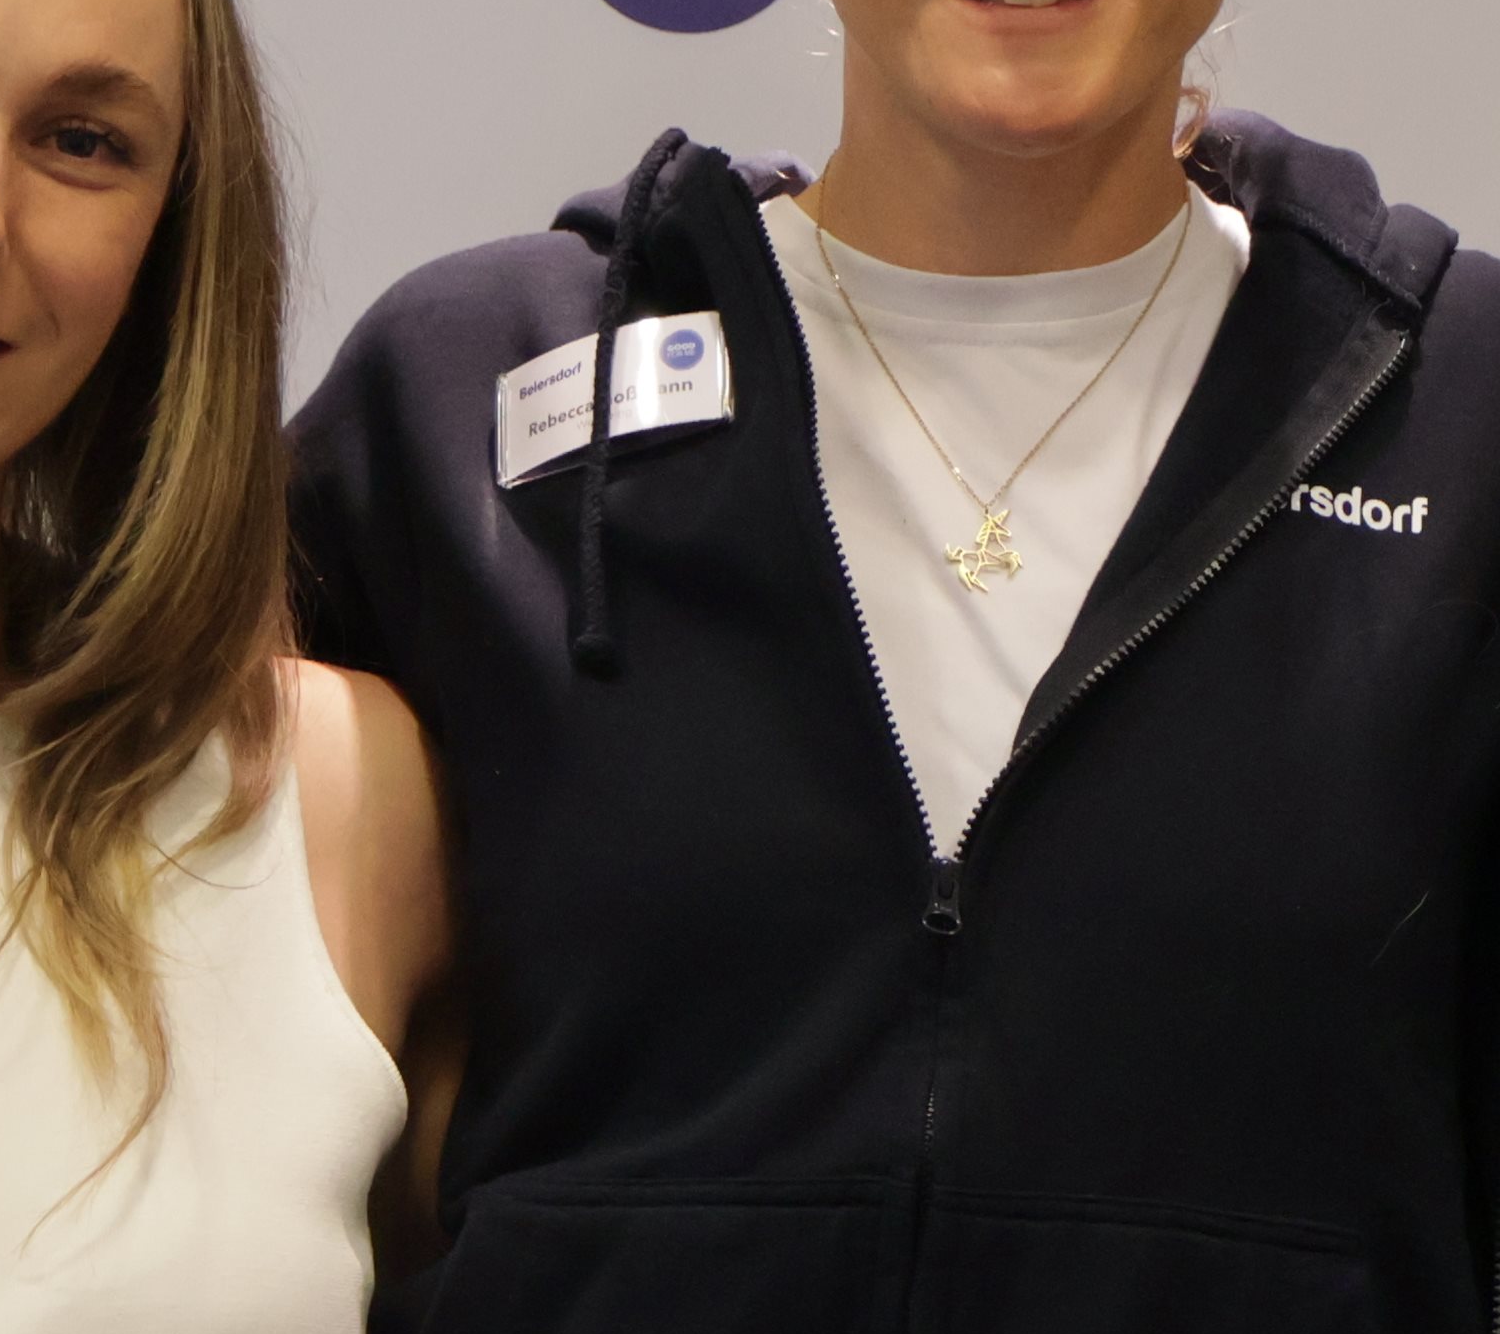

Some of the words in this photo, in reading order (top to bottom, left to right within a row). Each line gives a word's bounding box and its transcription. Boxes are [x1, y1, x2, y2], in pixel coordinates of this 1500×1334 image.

[519, 362, 582, 400] Beiersdorf
[528, 401, 594, 437] Rebecca
[610, 379, 693, 405] oßann
[1291, 484, 1428, 534] rsdorf
